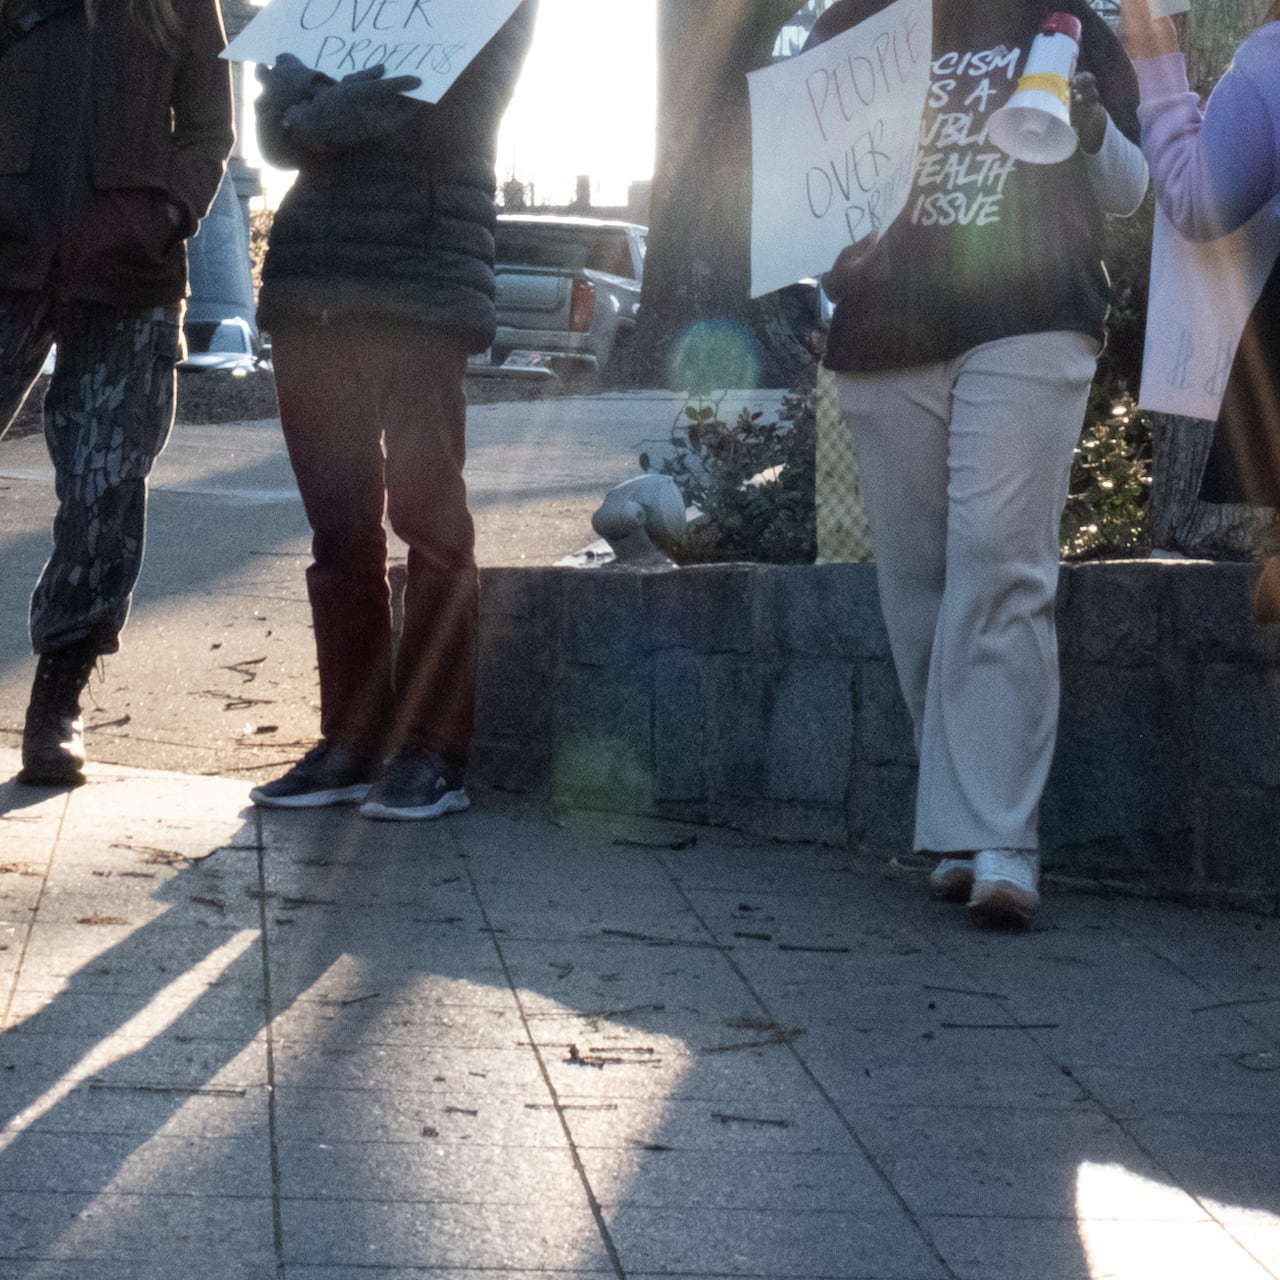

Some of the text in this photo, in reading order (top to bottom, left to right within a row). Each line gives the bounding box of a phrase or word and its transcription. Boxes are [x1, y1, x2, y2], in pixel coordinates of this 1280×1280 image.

[930, 47, 1021, 79] CISM
[965, 78, 998, 113] A
[805, 119, 891, 219] OVER
[917, 151, 1017, 192] EALTH
[912, 192, 1005, 226] ISSUE
